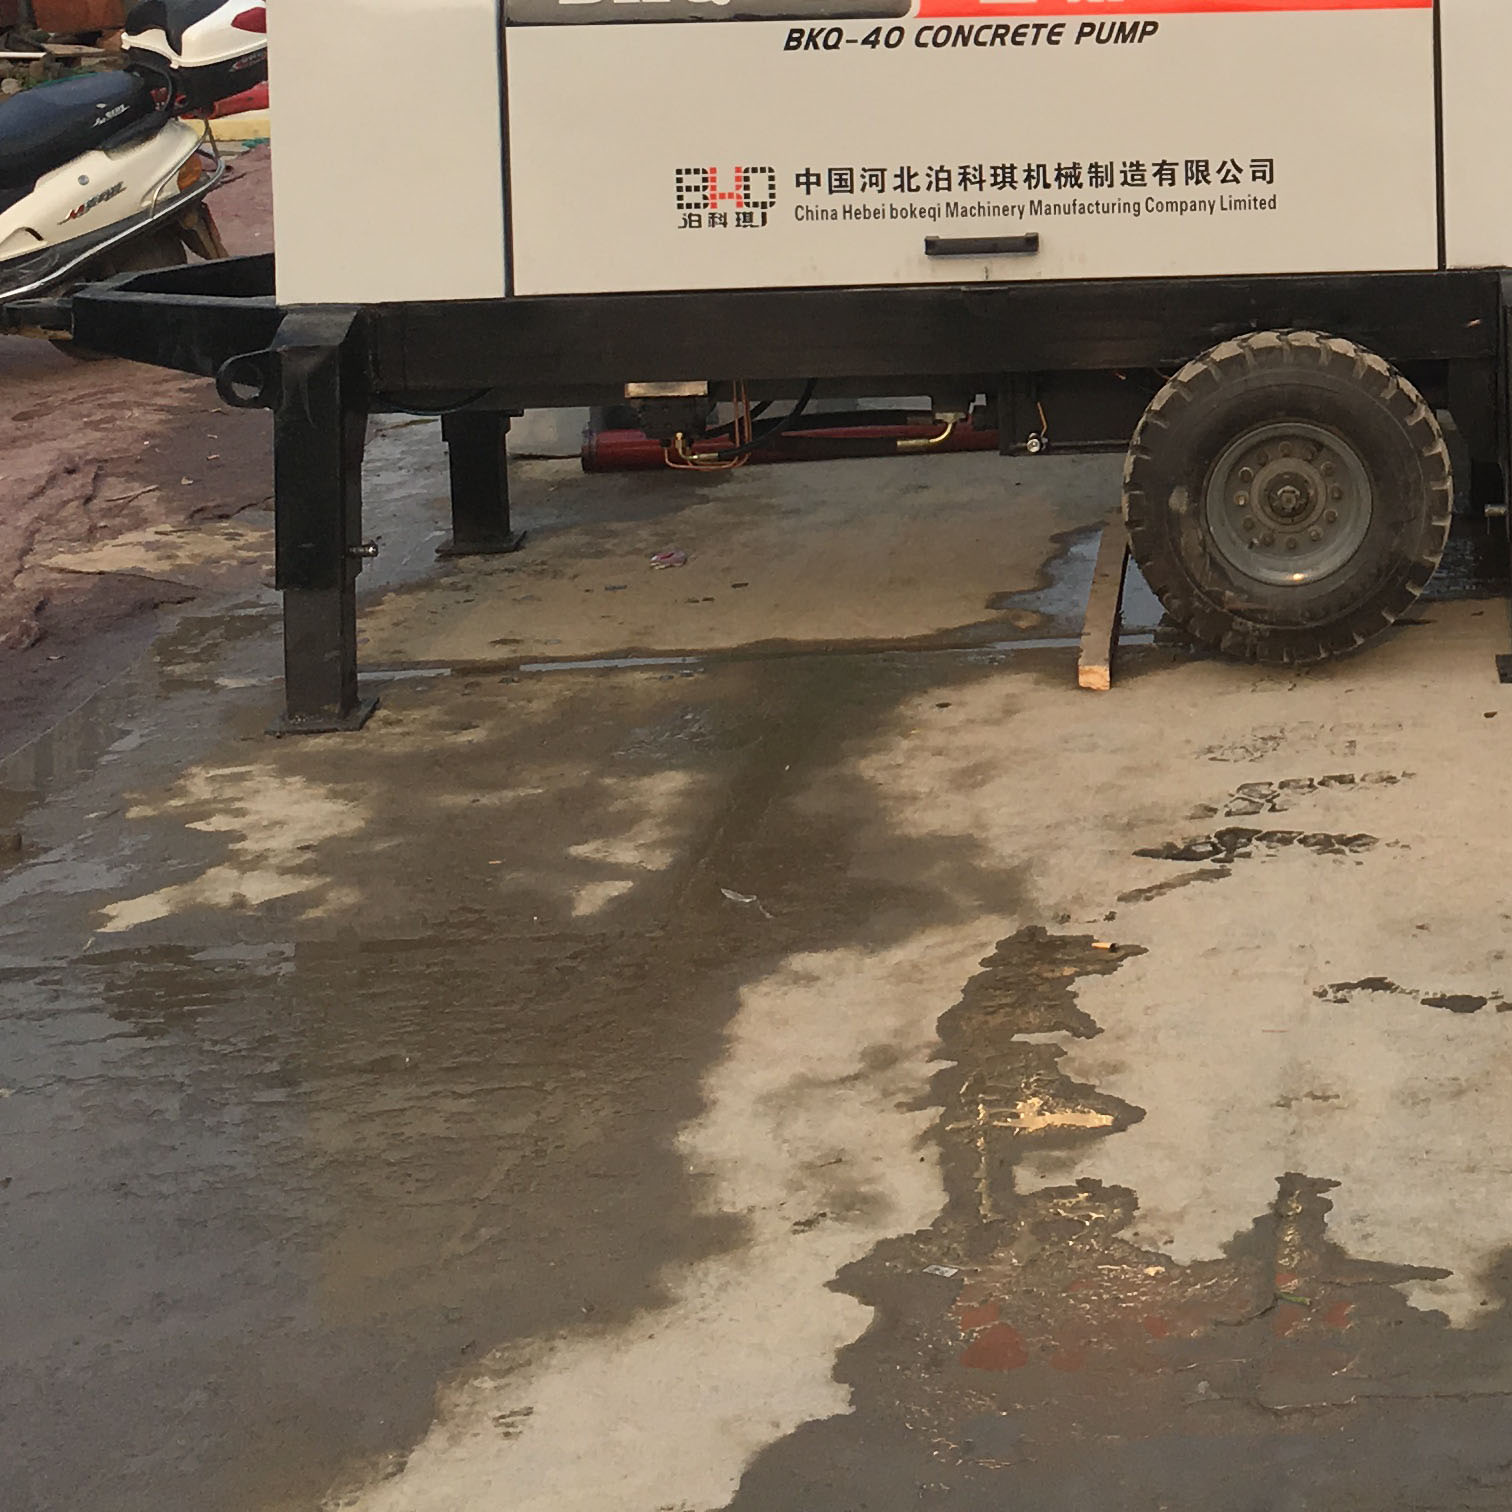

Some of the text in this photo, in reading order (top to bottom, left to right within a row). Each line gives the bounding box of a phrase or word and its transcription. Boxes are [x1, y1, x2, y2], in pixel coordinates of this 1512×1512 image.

[783, 21, 1159, 51] BKQ-40 CONCRETE PUMP
[795, 158, 1276, 196] 中国河北泊科琪机械制造有限公司
[794, 193, 1277, 222] China Hebei bokeqi Machinery Manufacturing Company Limited
